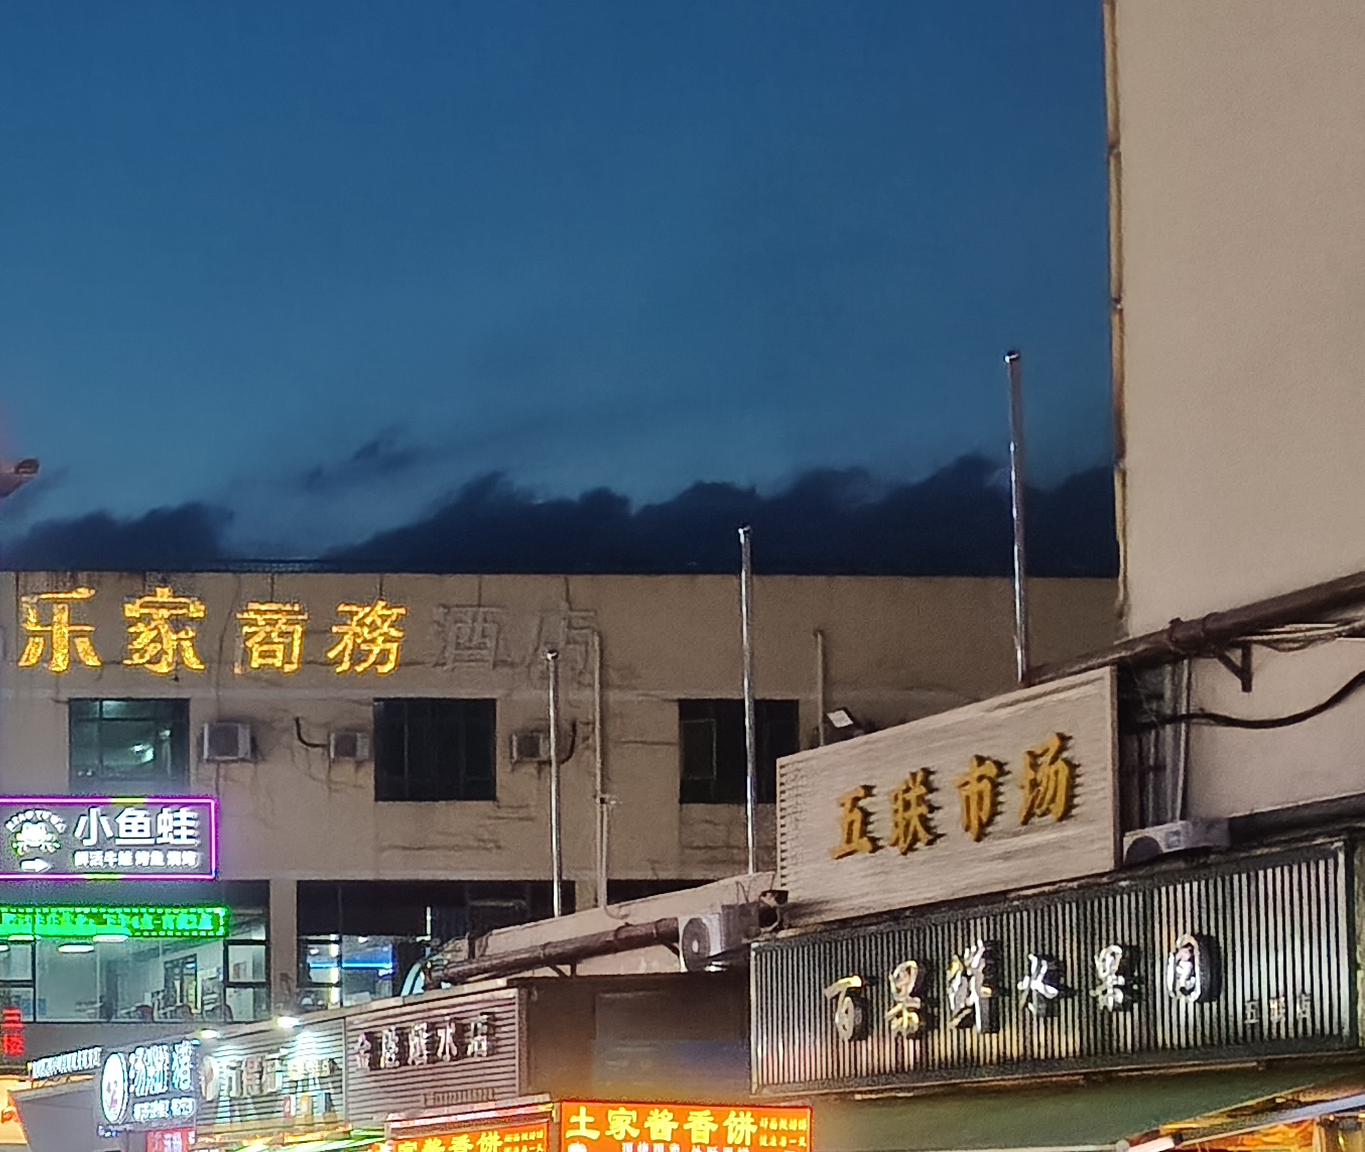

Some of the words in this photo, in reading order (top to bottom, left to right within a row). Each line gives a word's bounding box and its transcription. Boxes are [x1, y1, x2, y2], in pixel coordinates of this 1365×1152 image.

[831, 731, 1080, 860] 五联市场
[73, 806, 199, 847] 小鱼蛙
[565, 1105, 758, 1147] 土家酱香饼
